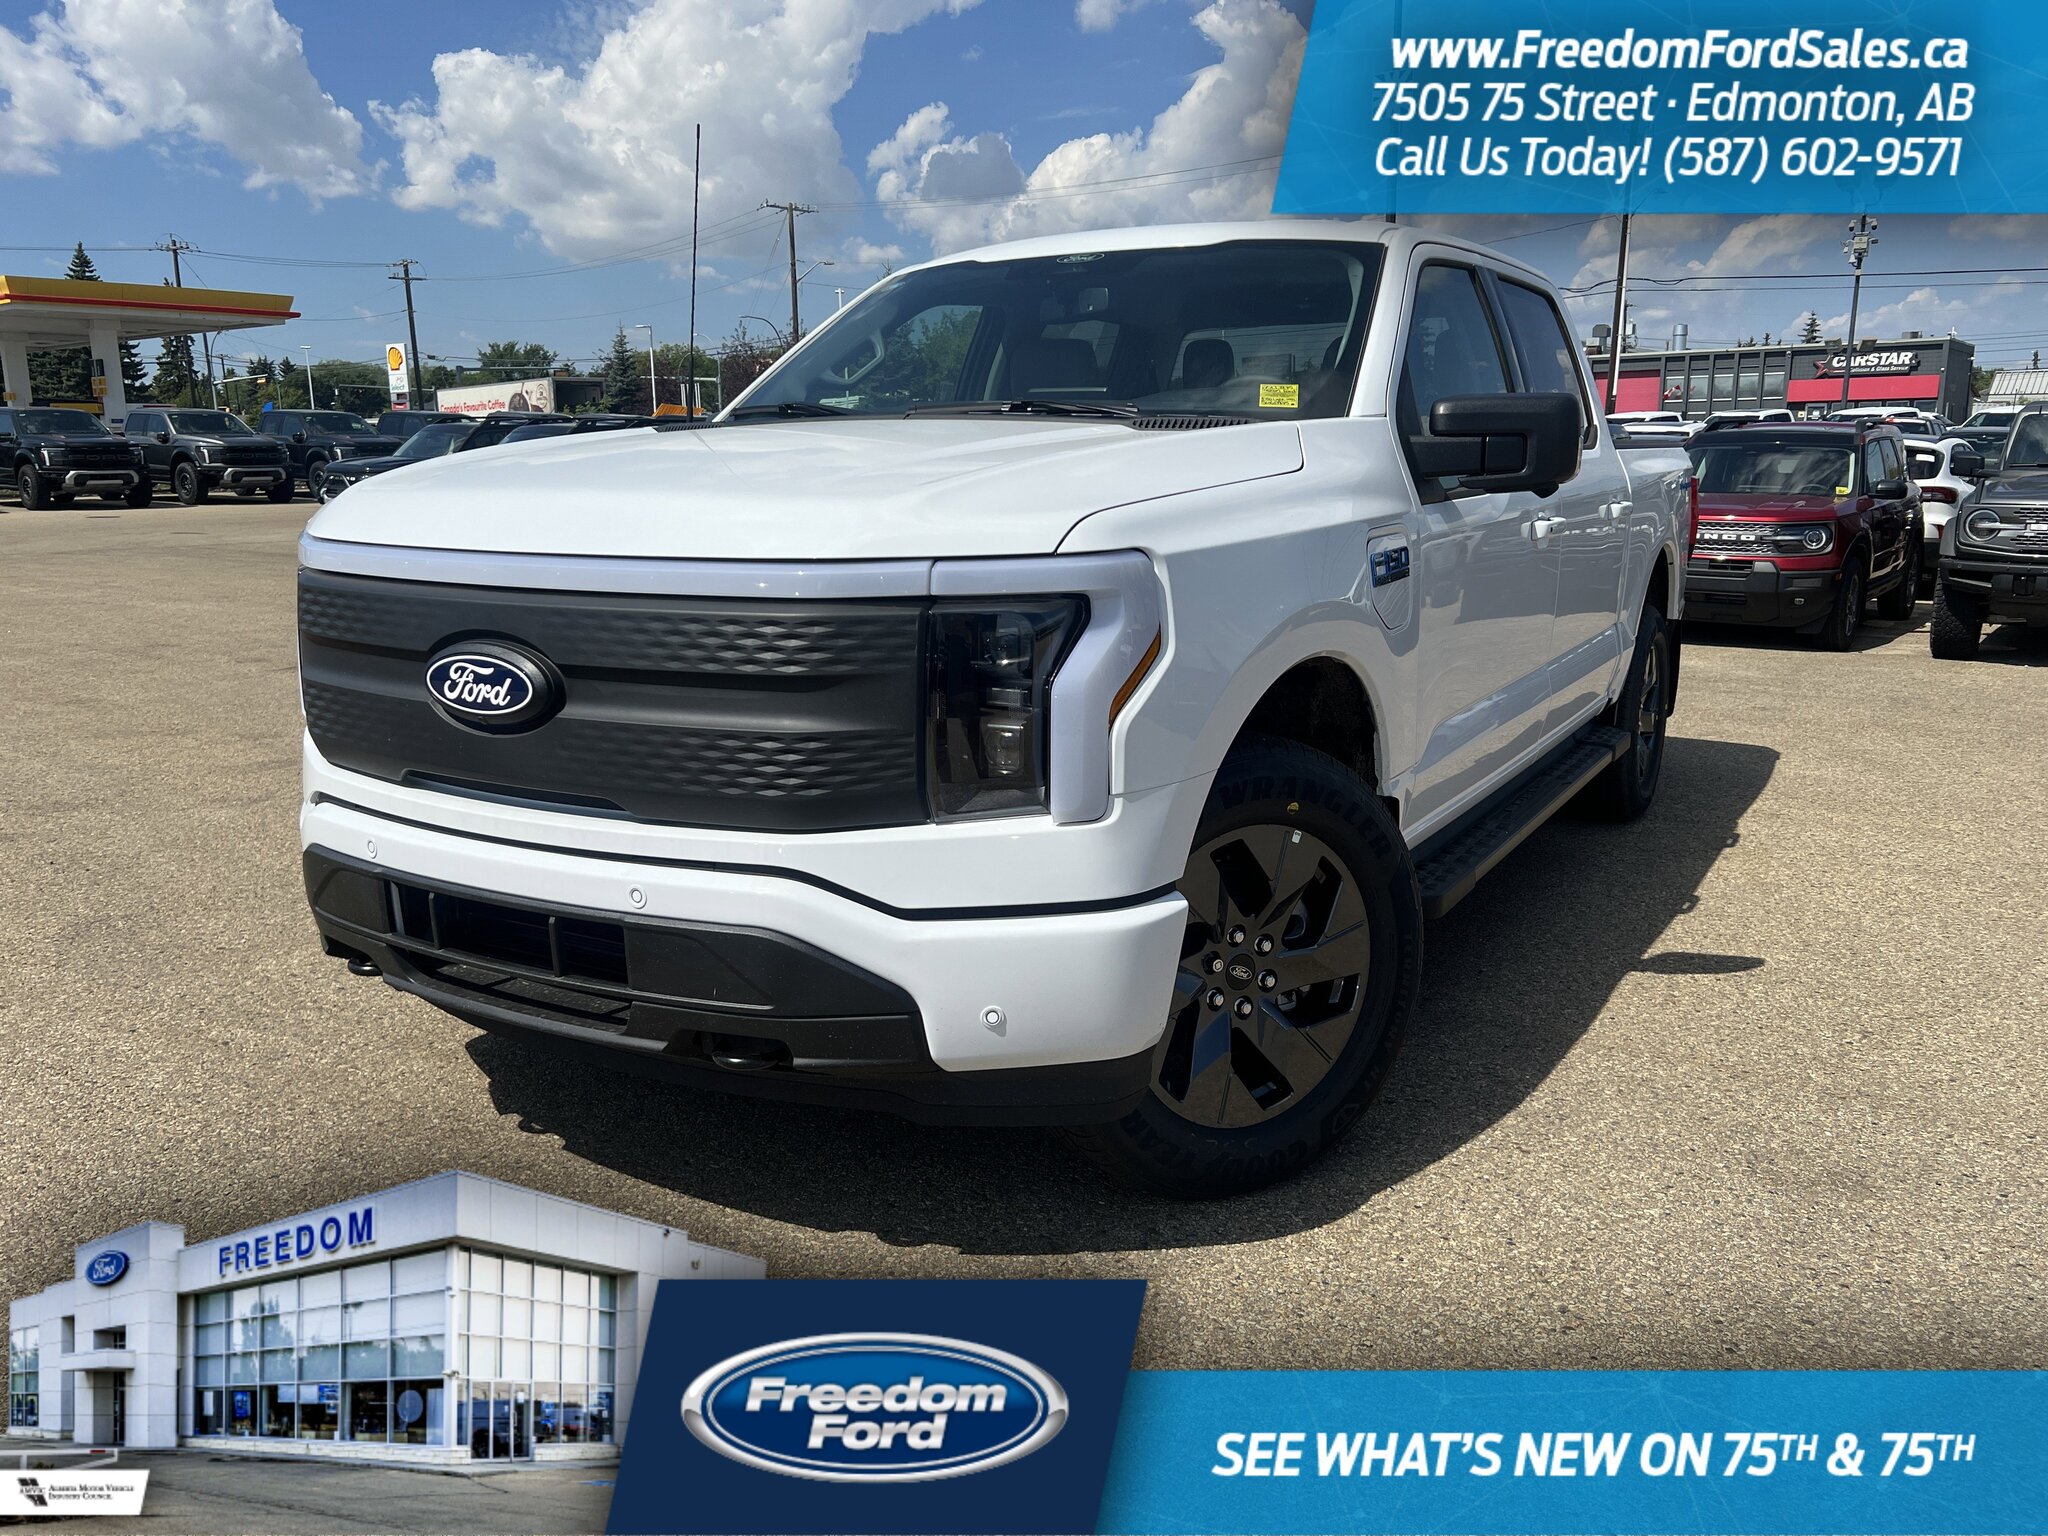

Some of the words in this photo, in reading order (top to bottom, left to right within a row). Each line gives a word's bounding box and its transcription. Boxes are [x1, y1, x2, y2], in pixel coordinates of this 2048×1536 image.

[1832, 352, 1912, 367] CARSTAR
[463, 401, 487, 412] Favourite
[488, 399, 506, 410] Coffee
[1696, 533, 1756, 541] NCO
[443, 661, 513, 707] Ford
